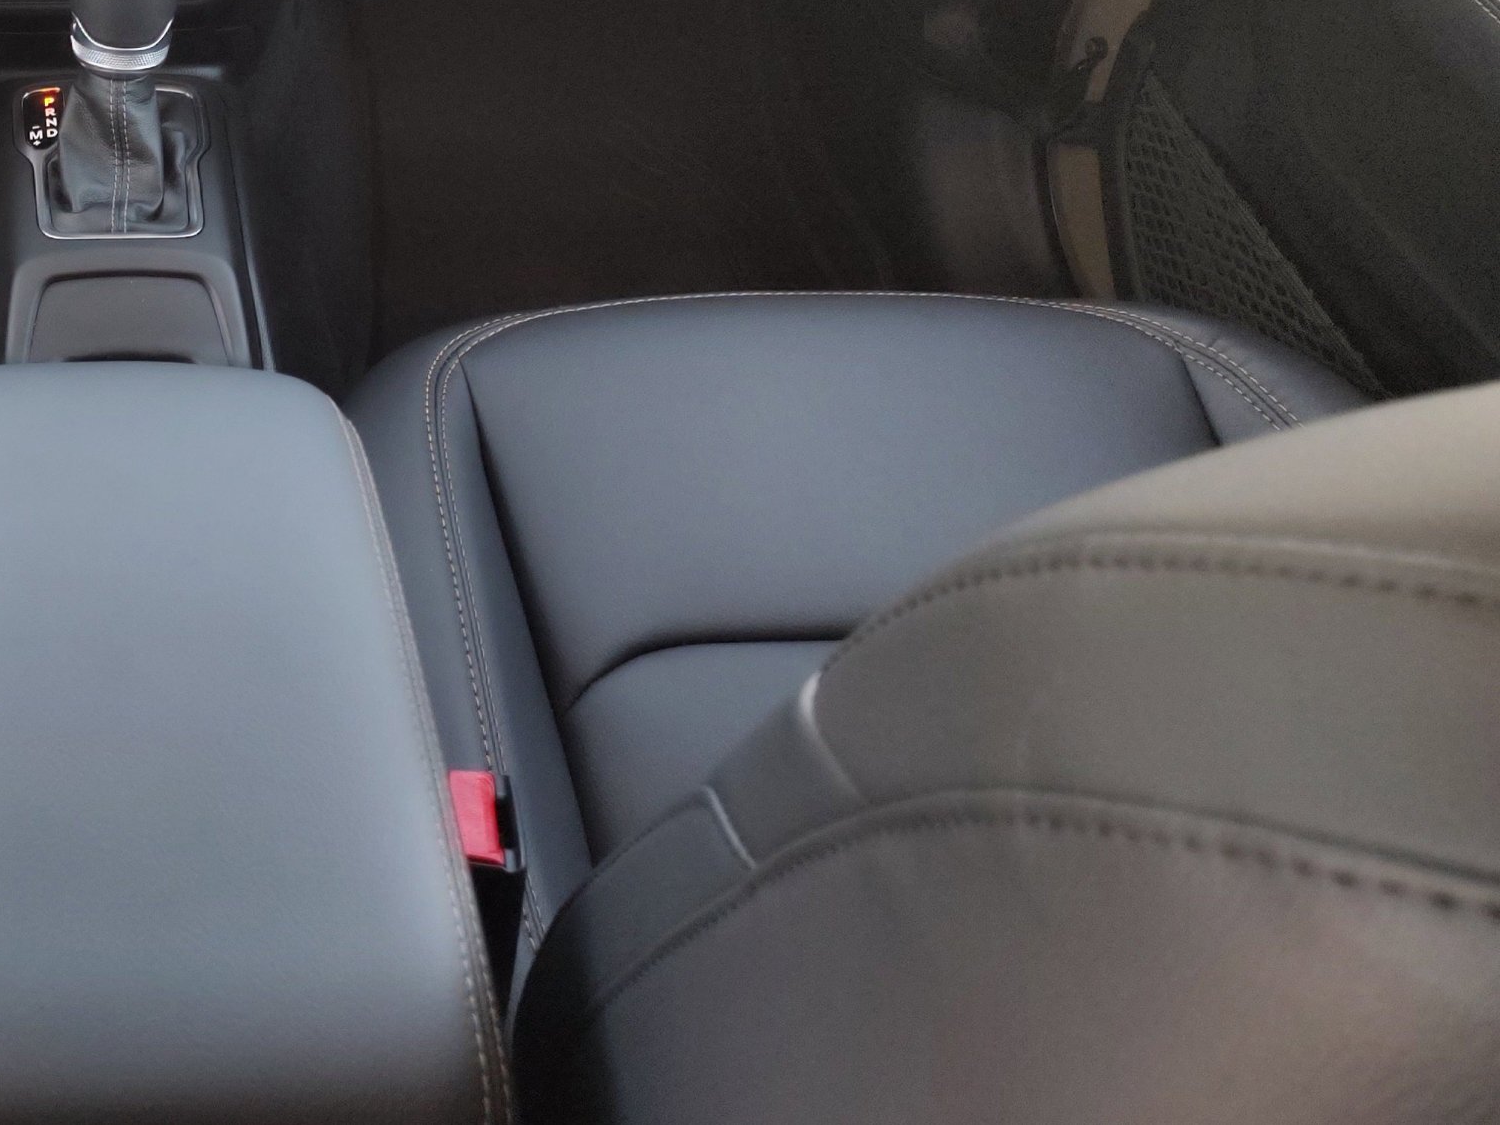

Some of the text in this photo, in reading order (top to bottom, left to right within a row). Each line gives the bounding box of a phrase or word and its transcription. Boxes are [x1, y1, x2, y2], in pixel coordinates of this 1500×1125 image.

[44, 97, 55, 107] P
[44, 107, 56, 117] R
[45, 117, 58, 127] N
[29, 129, 44, 141] M
[46, 128, 58, 138] D
